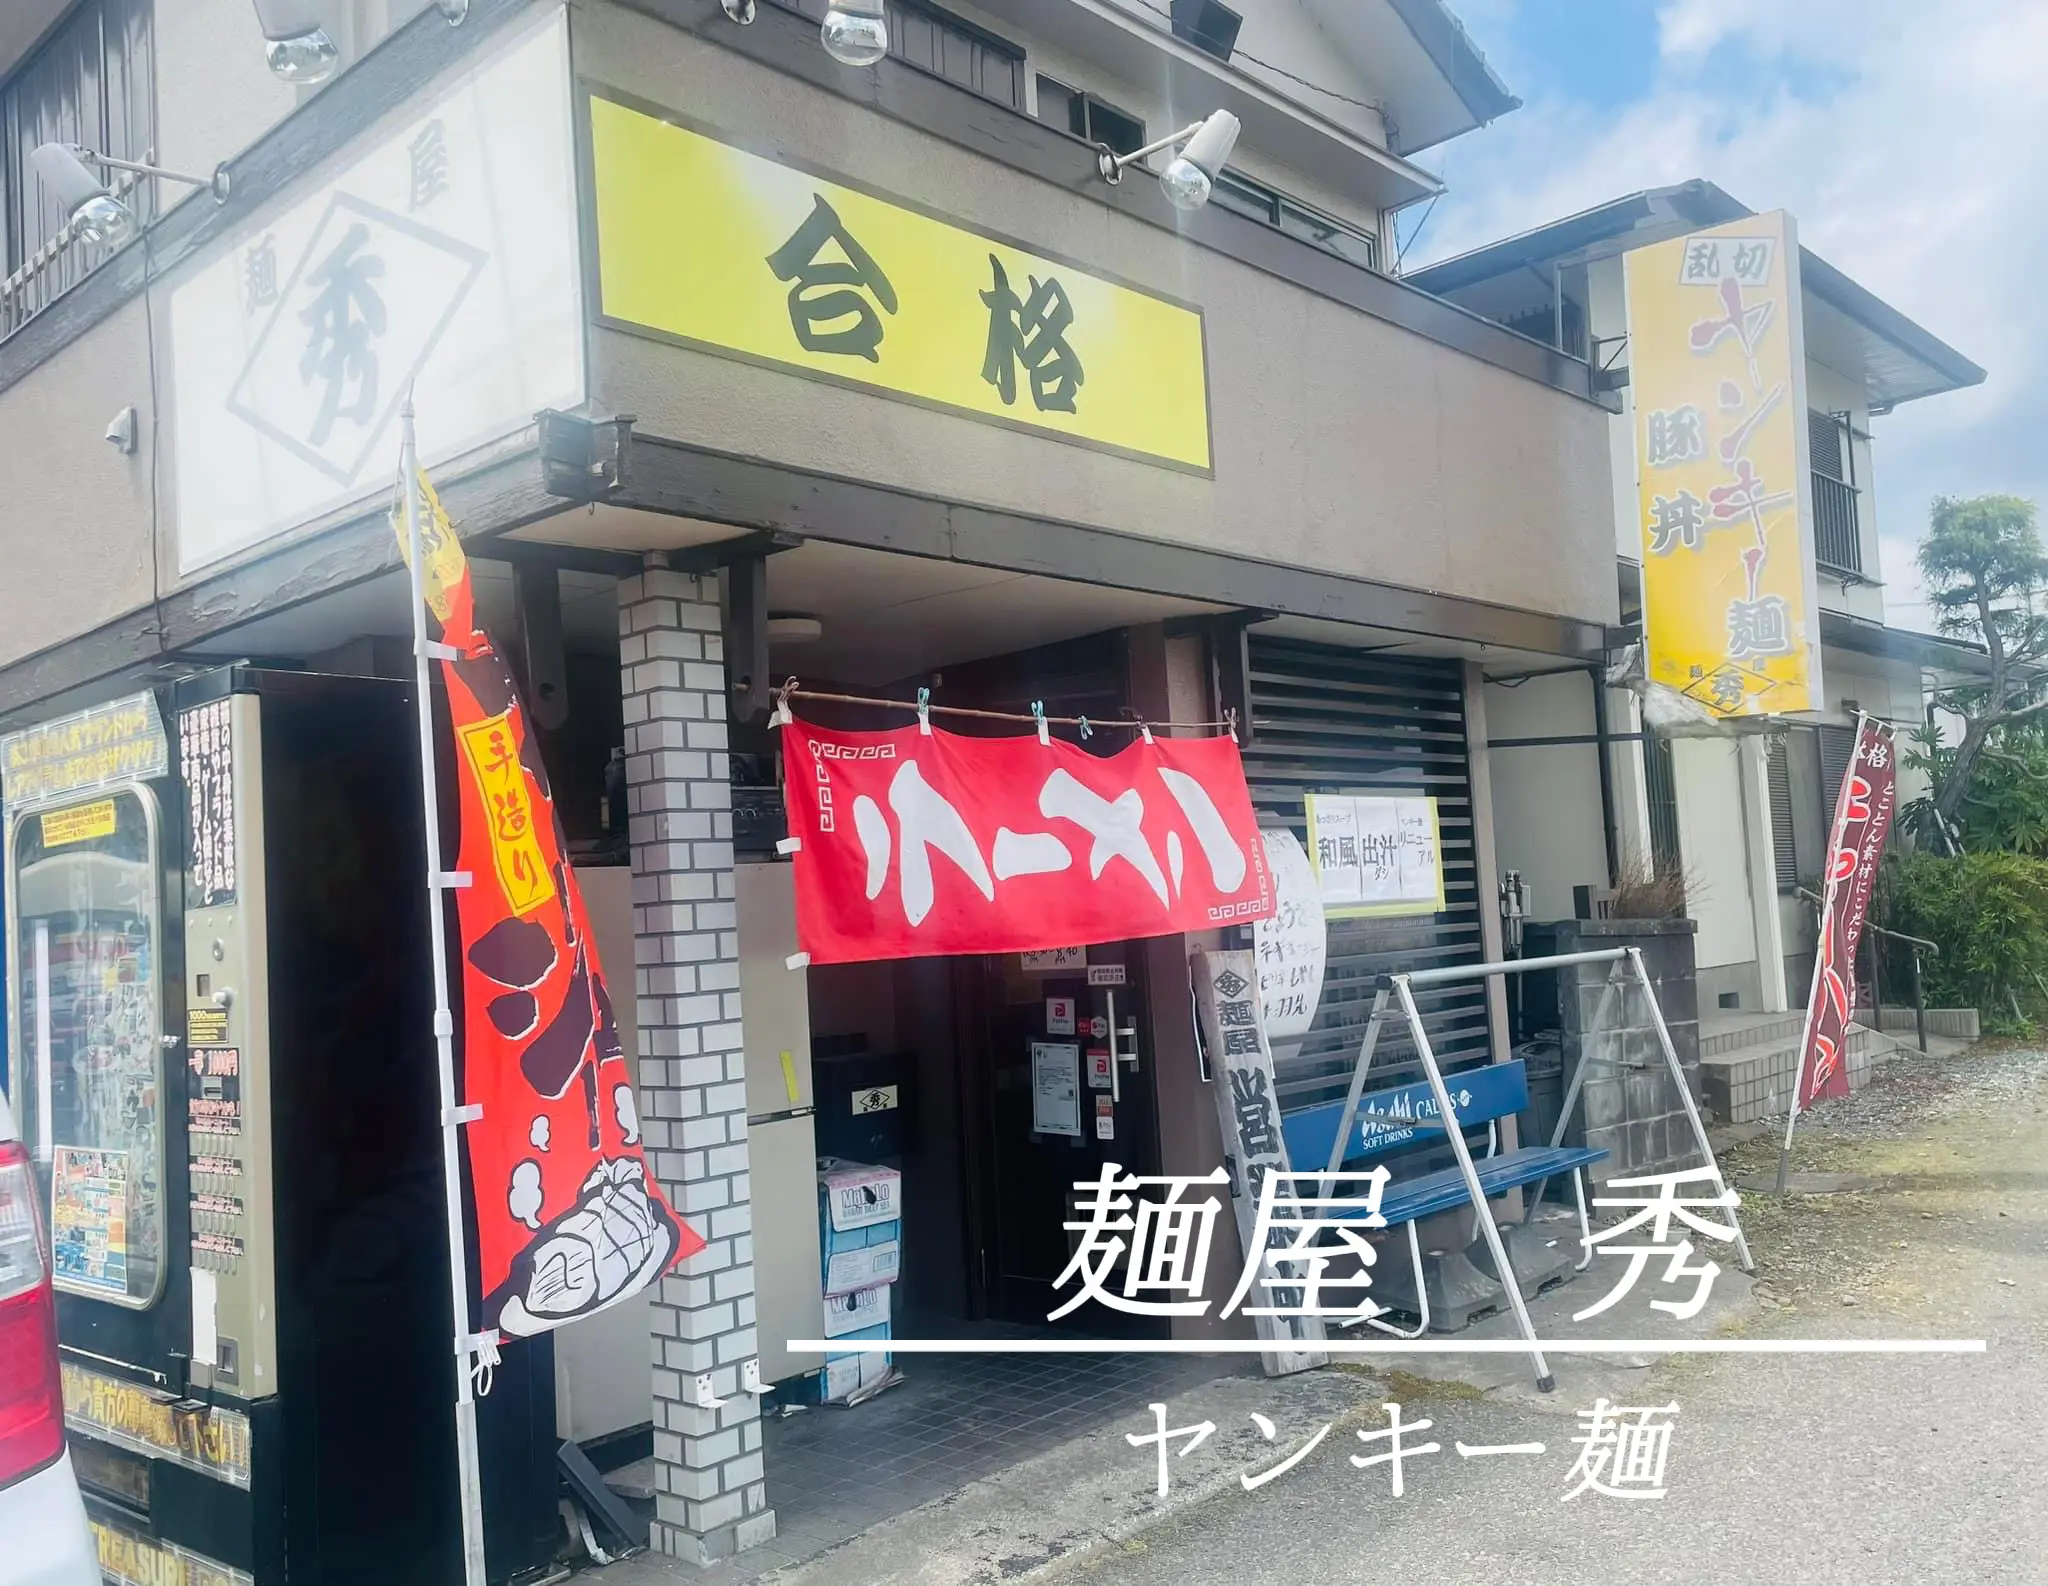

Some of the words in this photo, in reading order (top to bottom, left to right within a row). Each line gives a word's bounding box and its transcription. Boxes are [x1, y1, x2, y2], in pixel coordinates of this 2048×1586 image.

[301, 222, 387, 447] 秀
[765, 193, 1084, 414] 合格
[1647, 404, 1704, 553] 豚丼
[1690, 277, 1794, 658] ヤンキー麺
[484, 730, 539, 900] 手造り
[1318, 834, 1398, 869] 和風出汁
[1399, 831, 1433, 848] リニュー
[1417, 848, 1434, 866] アル
[1363, 1135, 1383, 1150] SOFT
[1384, 1127, 1413, 1144] DRINKS
[1415, 1093, 1457, 1120] CALS
